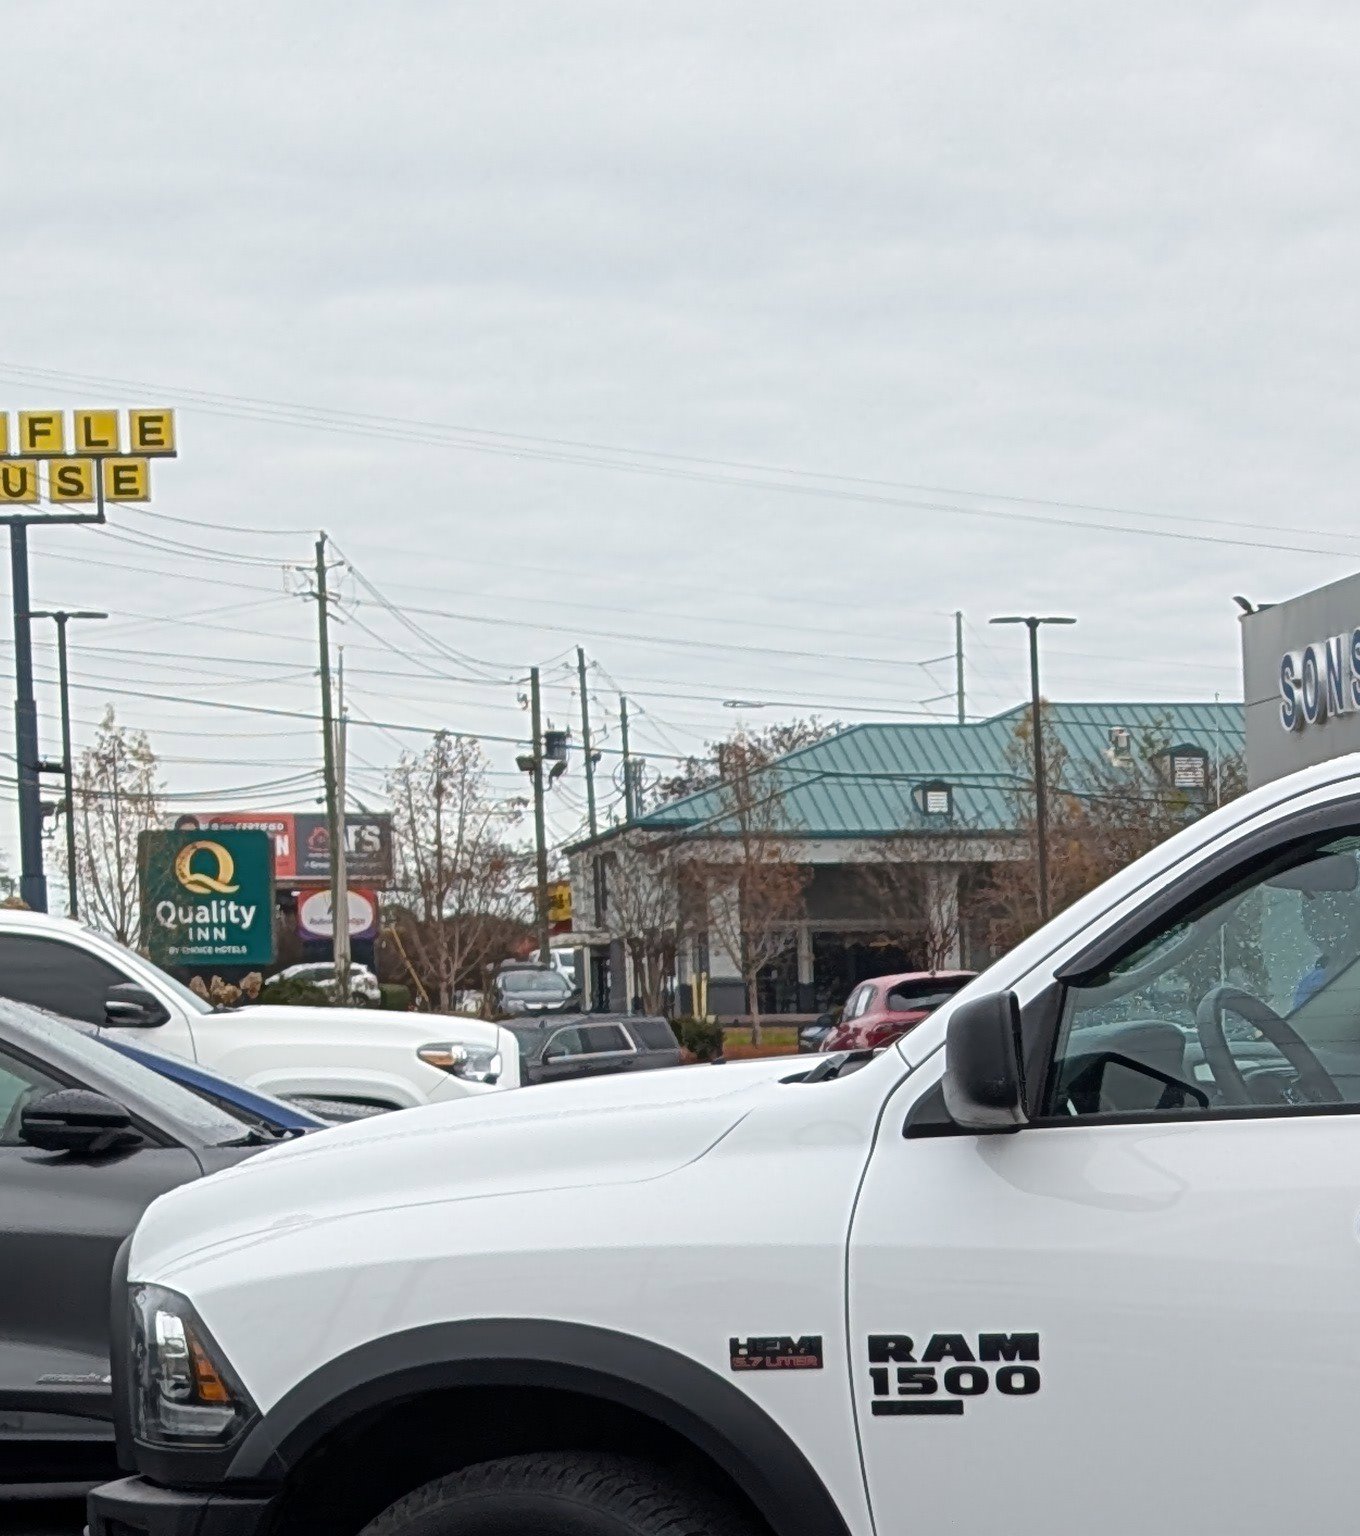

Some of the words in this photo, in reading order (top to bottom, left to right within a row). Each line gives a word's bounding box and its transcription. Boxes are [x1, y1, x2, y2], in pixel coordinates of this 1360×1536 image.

[28, 415, 165, 448] FLE
[156, 900, 257, 929] Quality
[188, 927, 227, 942] INN
[868, 1333, 1040, 1362] RAM
[868, 1366, 1041, 1395] 1500
